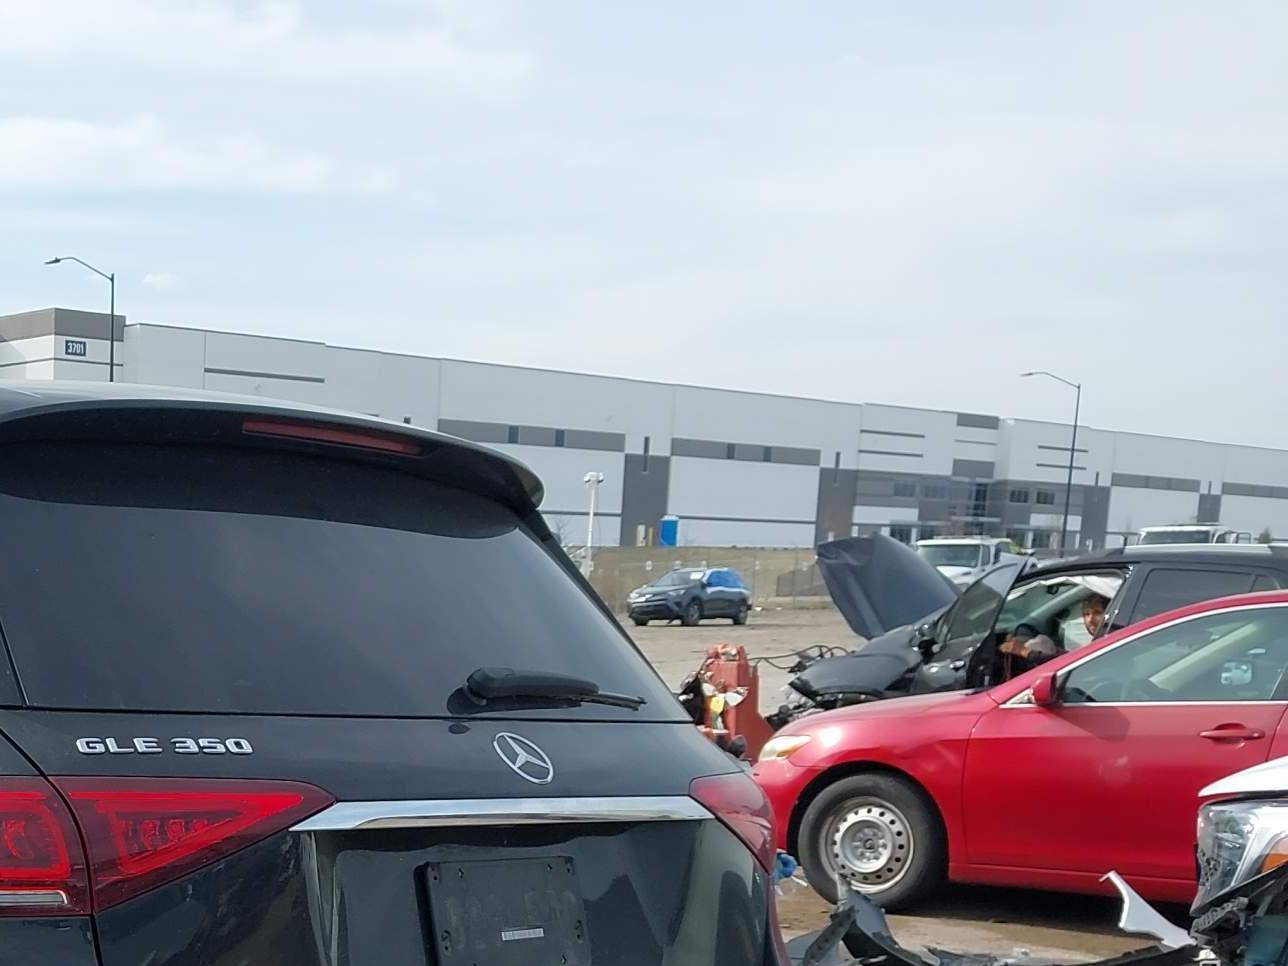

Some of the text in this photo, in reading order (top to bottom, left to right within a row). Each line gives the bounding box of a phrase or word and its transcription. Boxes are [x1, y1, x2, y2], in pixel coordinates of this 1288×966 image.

[67, 342, 84, 354] 3701
[75, 737, 254, 754] GLE 350
